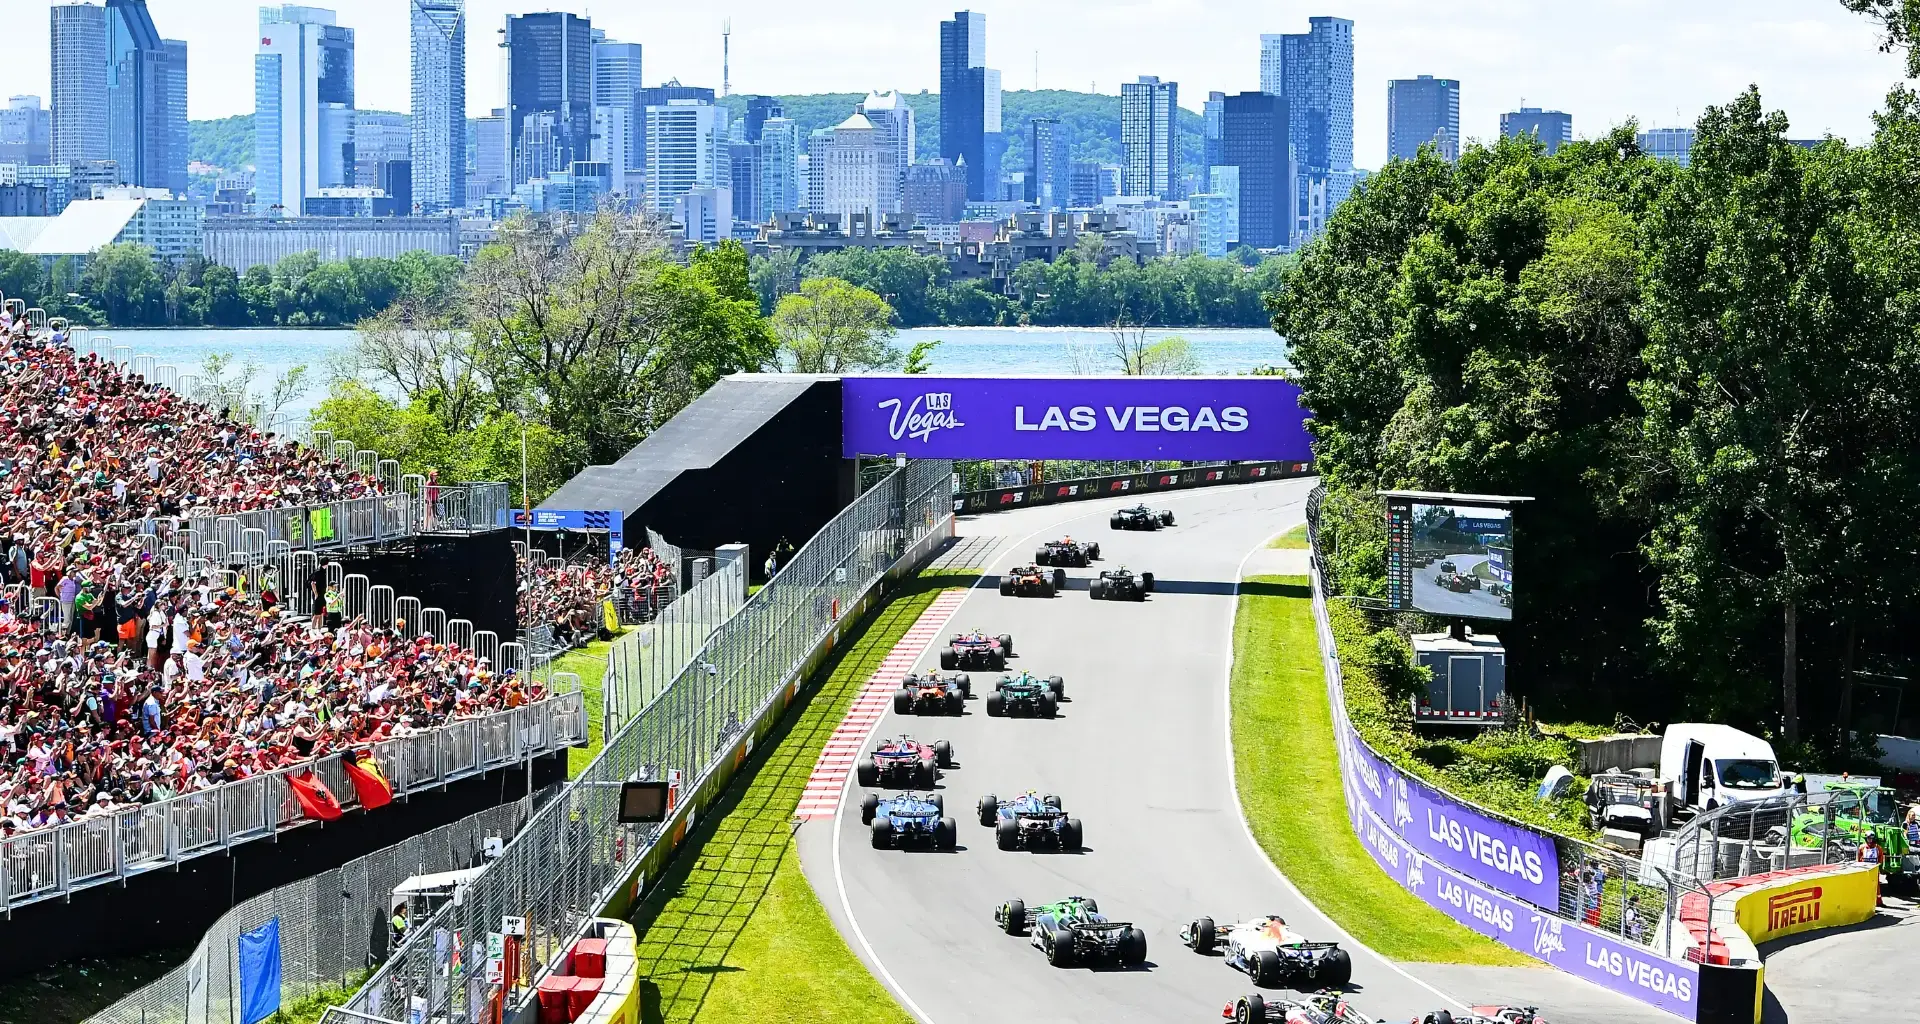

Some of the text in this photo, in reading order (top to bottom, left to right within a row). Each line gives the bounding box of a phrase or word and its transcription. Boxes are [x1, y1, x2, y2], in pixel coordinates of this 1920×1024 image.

[878, 396, 965, 443] Vegas
[927, 394, 950, 409] LAS
[1015, 406, 1249, 431] LAS VEGAS
[1427, 808, 1544, 885] LAS VEGAS
[1437, 875, 1514, 933] LAS VEGAS
[1768, 886, 1823, 932] PIRELLI
[1230, 939, 1247, 960] VISA
[1531, 916, 1567, 960] Vegas
[1586, 942, 1692, 1002] LAS VEGAS
